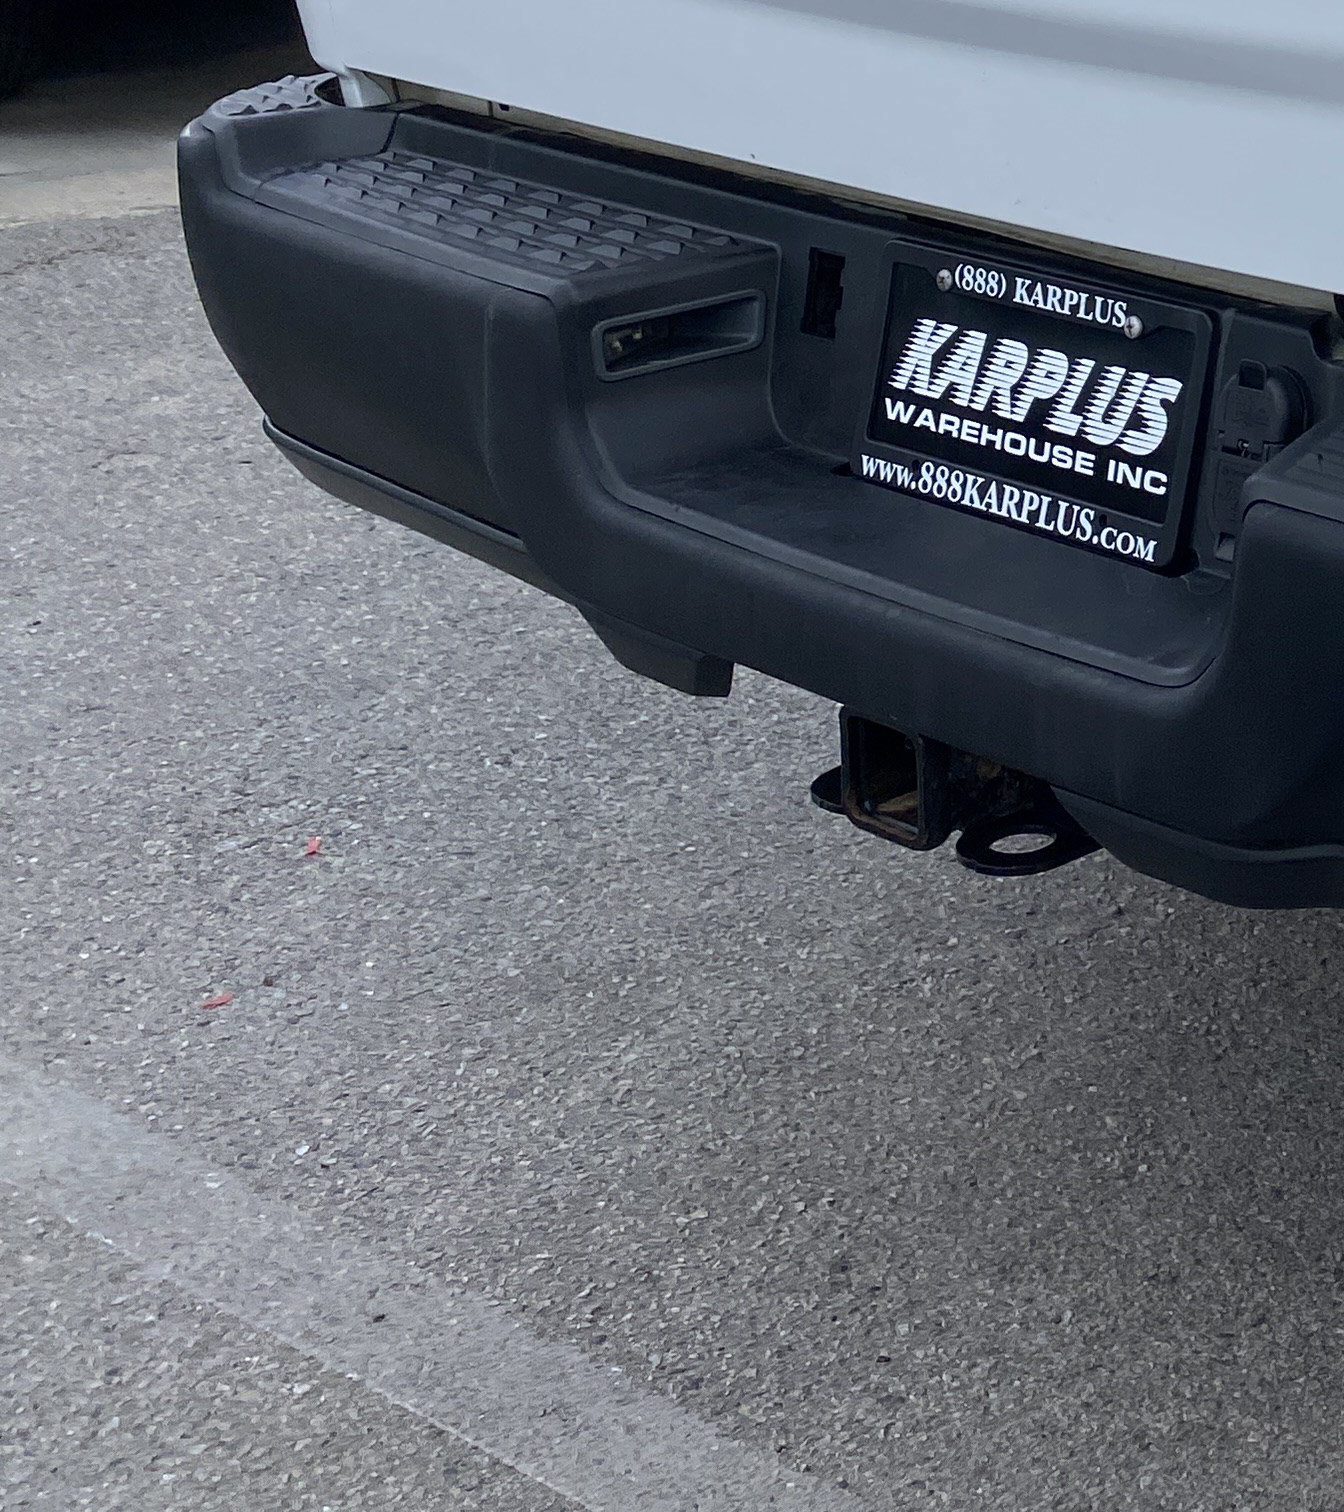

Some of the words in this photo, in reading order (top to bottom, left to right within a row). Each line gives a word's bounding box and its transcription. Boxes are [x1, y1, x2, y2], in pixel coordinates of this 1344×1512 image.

[954, 263, 1008, 301] (888)
[1012, 276, 1128, 328] KARPLUS
[887, 317, 1184, 456] KARPLUS
[884, 397, 1097, 477] WAREHOUSE
[1106, 458, 1169, 496] INC
